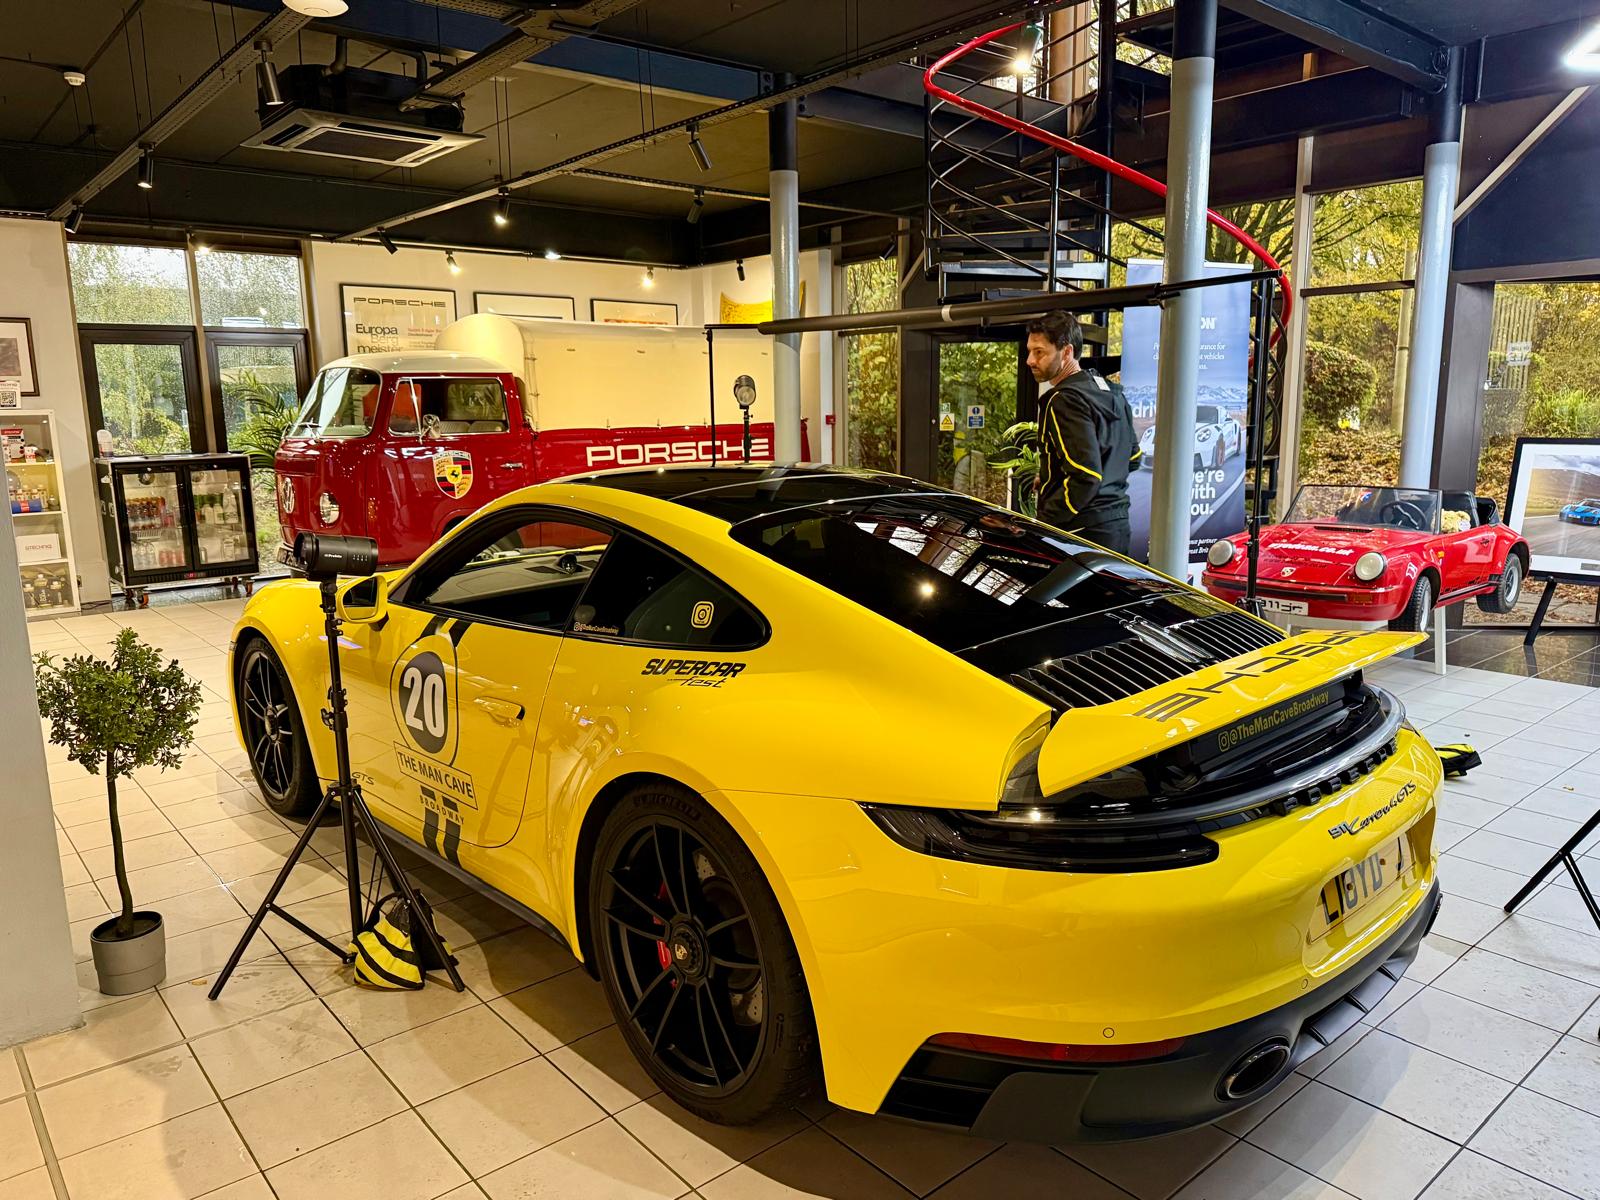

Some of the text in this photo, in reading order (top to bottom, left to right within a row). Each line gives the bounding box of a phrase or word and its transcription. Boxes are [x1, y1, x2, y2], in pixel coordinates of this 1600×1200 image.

[353, 297, 447, 308] PORSCHE
[355, 323, 399, 336] Europa
[371, 334, 399, 346] Berg
[586, 438, 770, 467] PORSCHE
[1192, 469, 1225, 483] e're
[1191, 483, 1216, 499] ith
[1190, 503, 1214, 515] ou.
[641, 658, 747, 678] SUPERCAR
[679, 676, 728, 688] fest
[403, 667, 445, 738] 20
[1230, 690, 1330, 745] @TheManCaveBroadway
[351, 771, 375, 786] GTS
[397, 751, 475, 800] THE MAN CAVE
[419, 795, 466, 825] BROADWAY
[1328, 821, 1350, 840] 911
[1396, 780, 1417, 806] GTS
